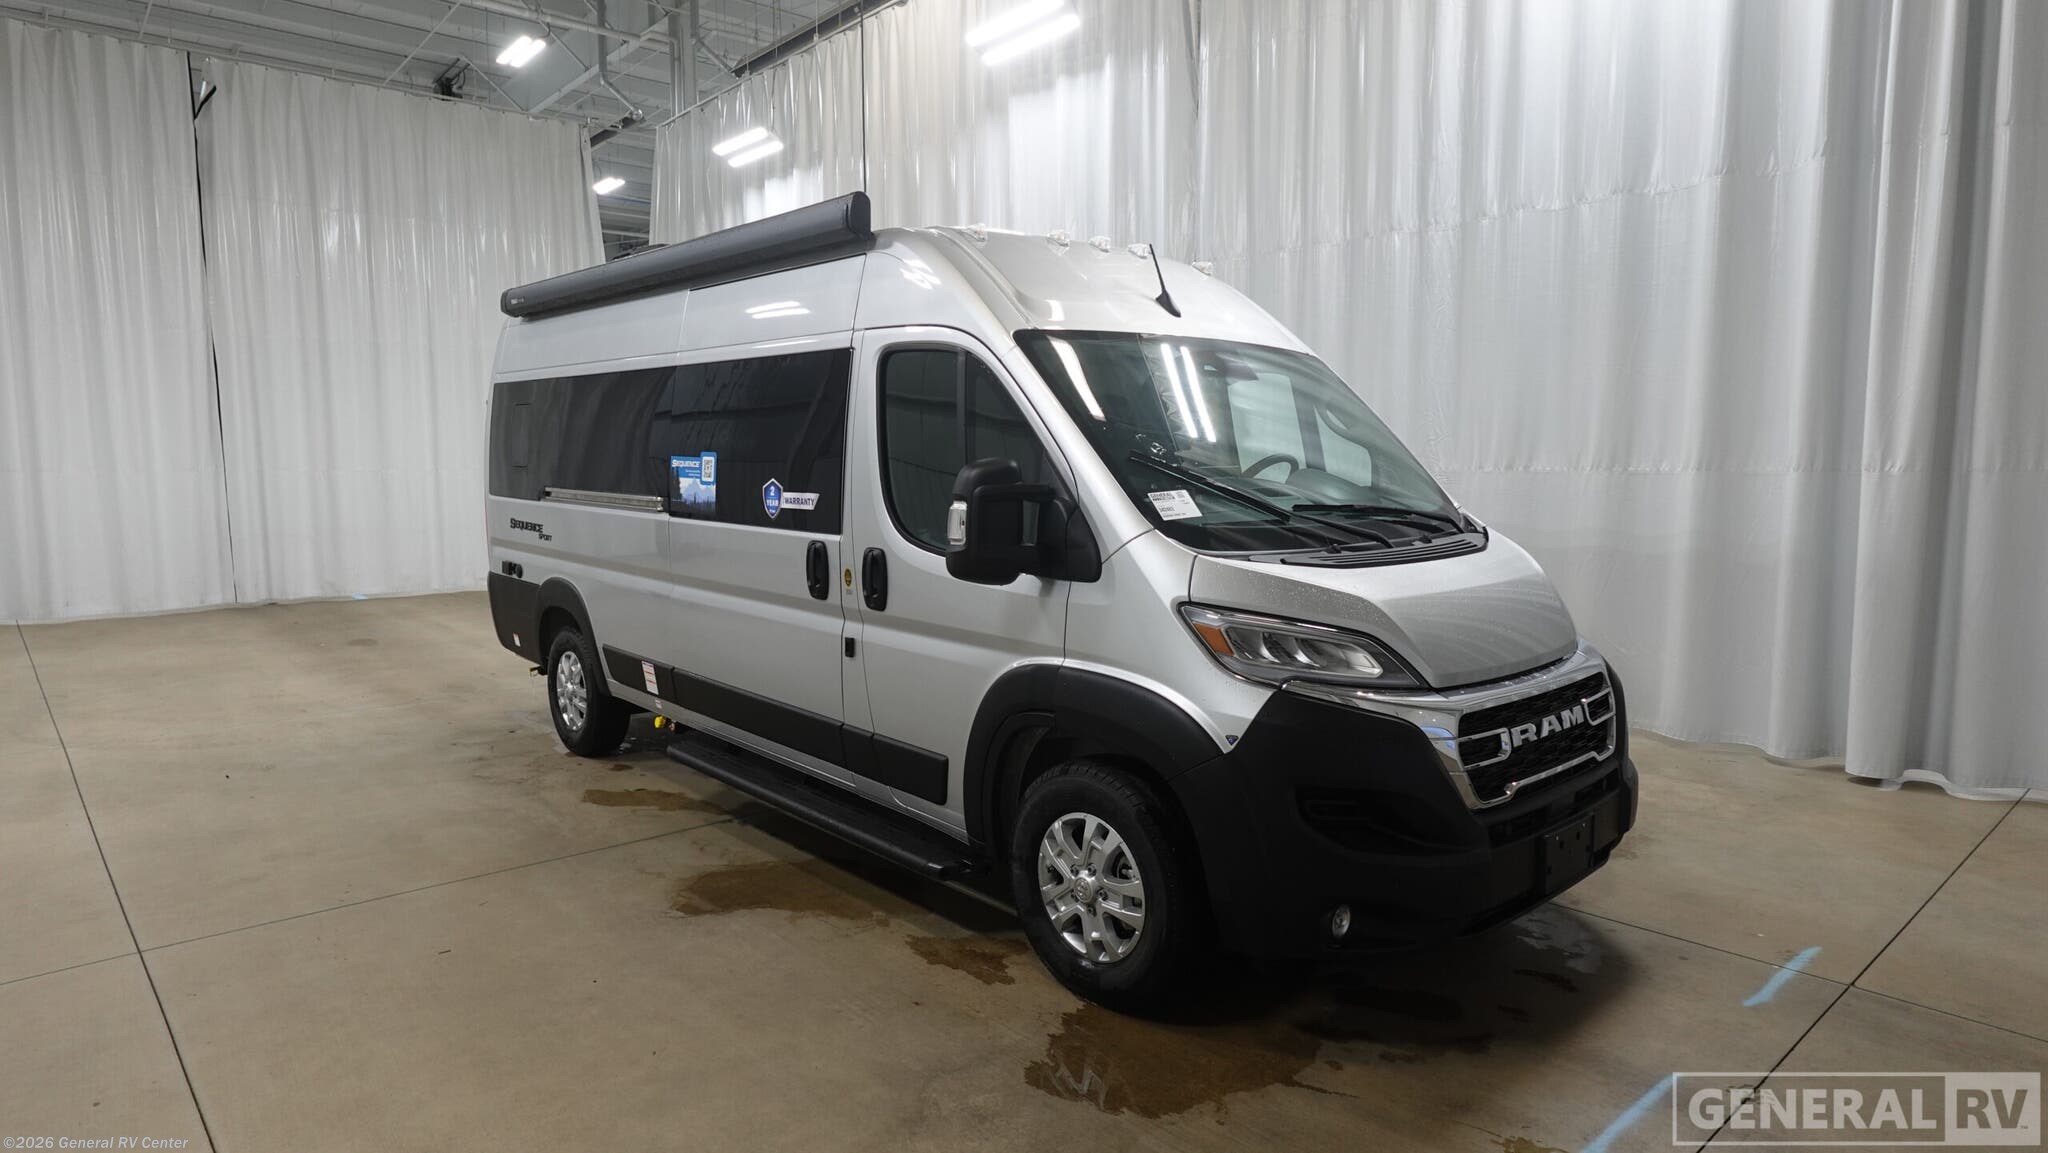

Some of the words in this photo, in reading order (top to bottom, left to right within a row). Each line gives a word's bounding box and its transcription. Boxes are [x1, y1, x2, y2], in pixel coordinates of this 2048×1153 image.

[769, 486, 776, 496] 2
[784, 496, 815, 506] WARRANTY
[1510, 704, 1584, 748] RAM
